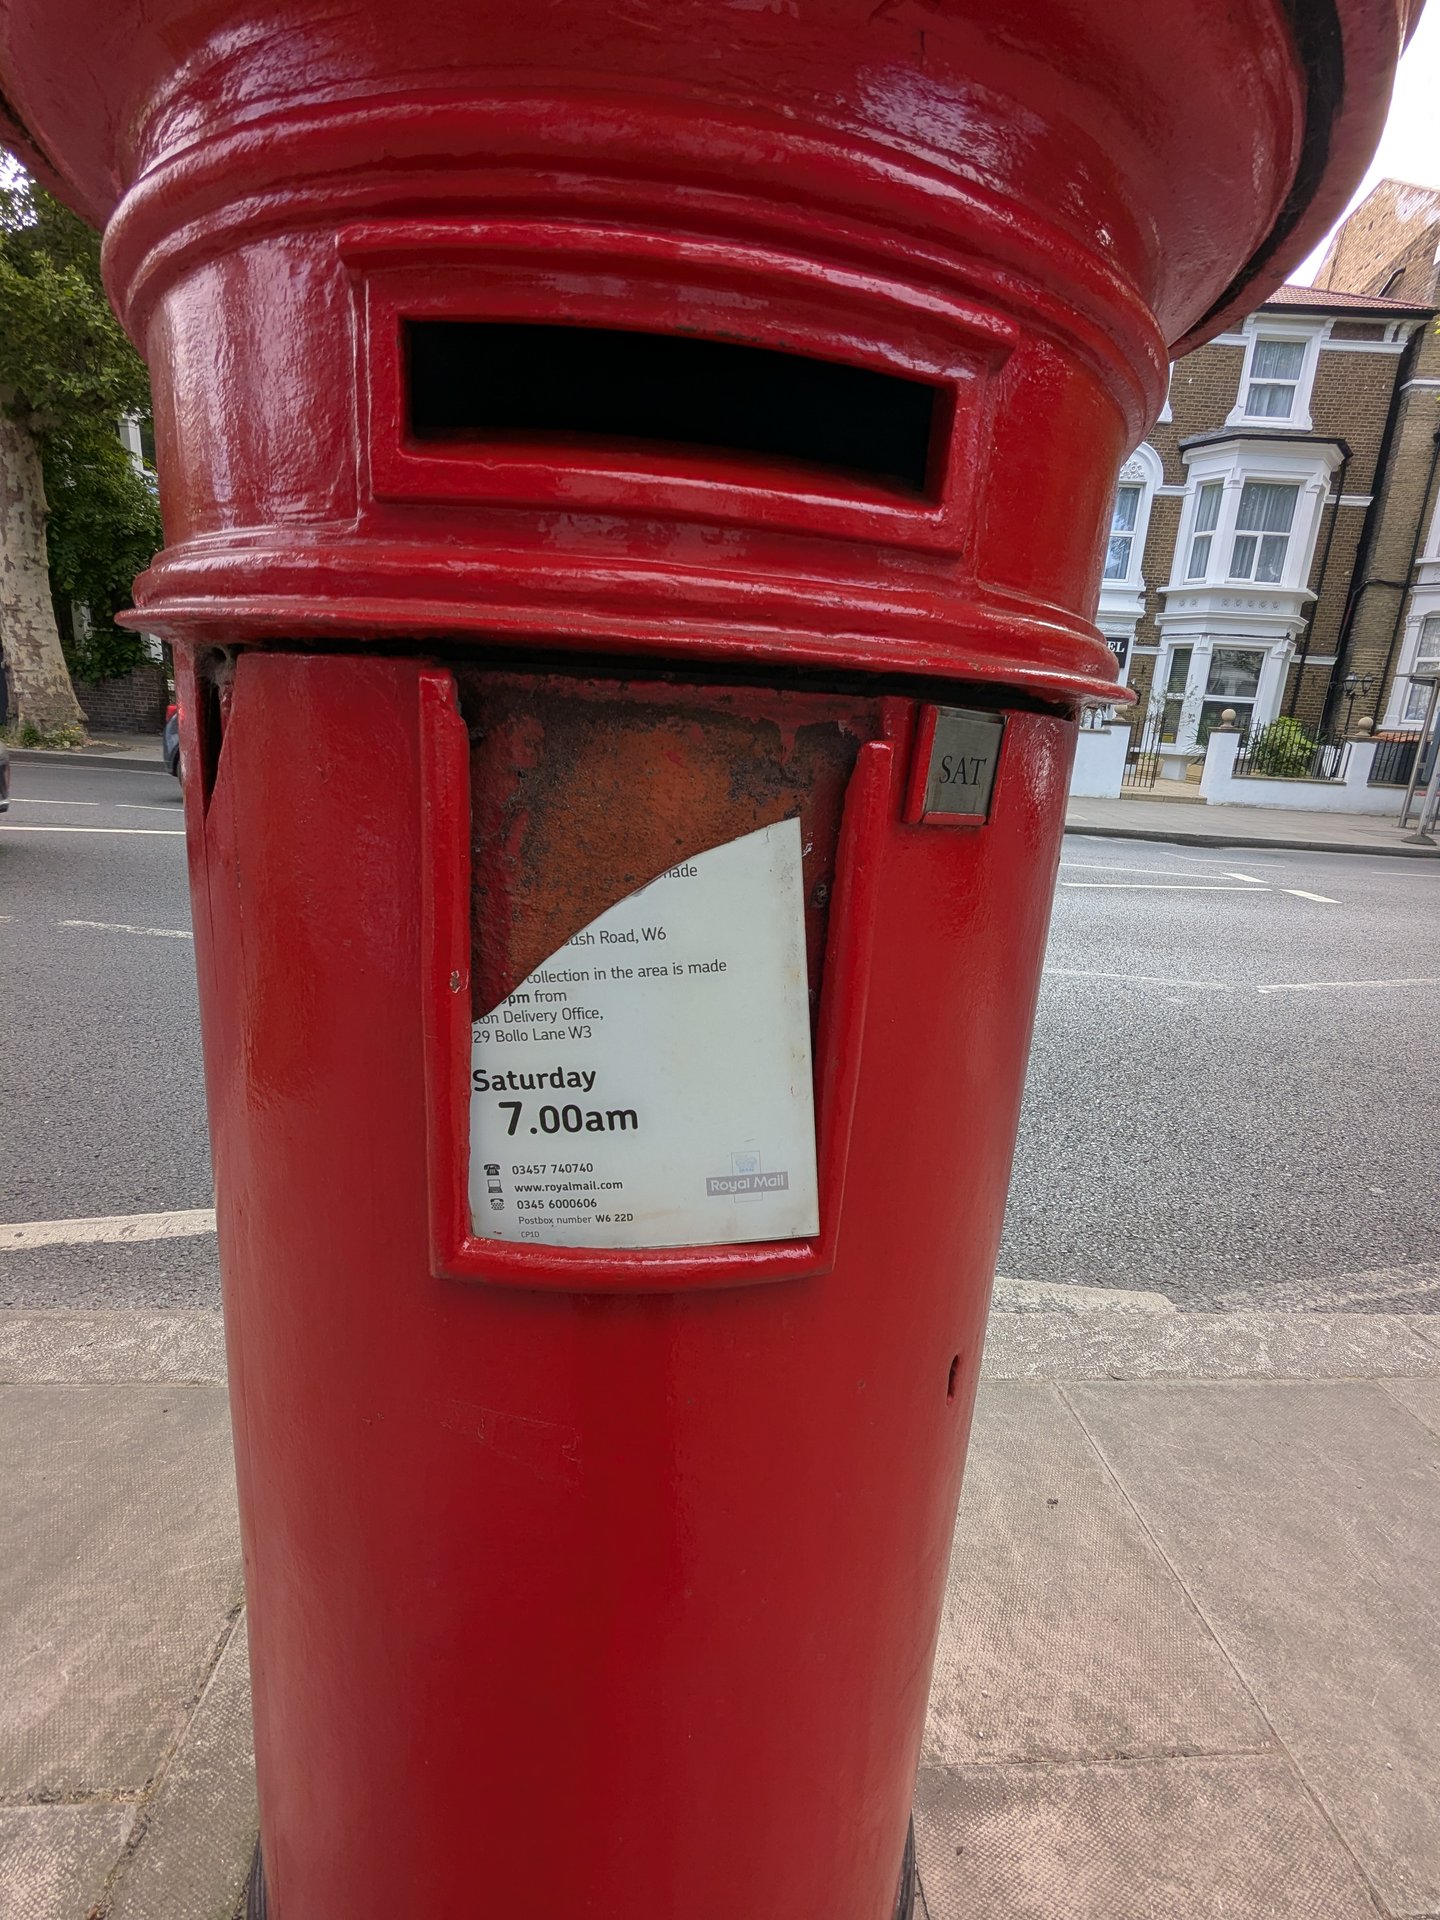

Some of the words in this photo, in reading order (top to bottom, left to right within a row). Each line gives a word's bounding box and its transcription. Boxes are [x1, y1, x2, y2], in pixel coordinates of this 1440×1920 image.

[939, 755, 987, 786] SAT
[565, 930, 595, 946] ush
[599, 929, 639, 946] Road,
[642, 927, 667, 942] W6
[526, 967, 590, 984] collection
[594, 967, 606, 981] in
[611, 966, 633, 980] the
[637, 965, 668, 978] area
[672, 961, 684, 975] is
[688, 959, 727, 974] made
[501, 991, 530, 1006] pm
[534, 990, 567, 1004] from
[504, 1008, 557, 1024] Delivery
[562, 1007, 604, 1022] Office,
[472, 1030, 490, 1044] 29
[495, 1029, 528, 1043] Bollo
[533, 1027, 565, 1041] Lane
[568, 1025, 592, 1040] W3
[472, 1066, 596, 1092] Saturday
[498, 1101, 639, 1136] 7.00am
[512, 1165, 547, 1175] 03457
[551, 1163, 594, 1174] 740740
[514, 1180, 623, 1194] www.royalmail.com
[710, 1178, 750, 1192] Royal
[754, 1174, 784, 1188] Mail
[517, 1199, 545, 1210] 0345
[548, 1198, 598, 1209] 6000606
[518, 1216, 553, 1225] Postbox
[557, 1215, 592, 1224] number
[595, 1214, 611, 1223] W6
[614, 1213, 634, 1222] 22D
